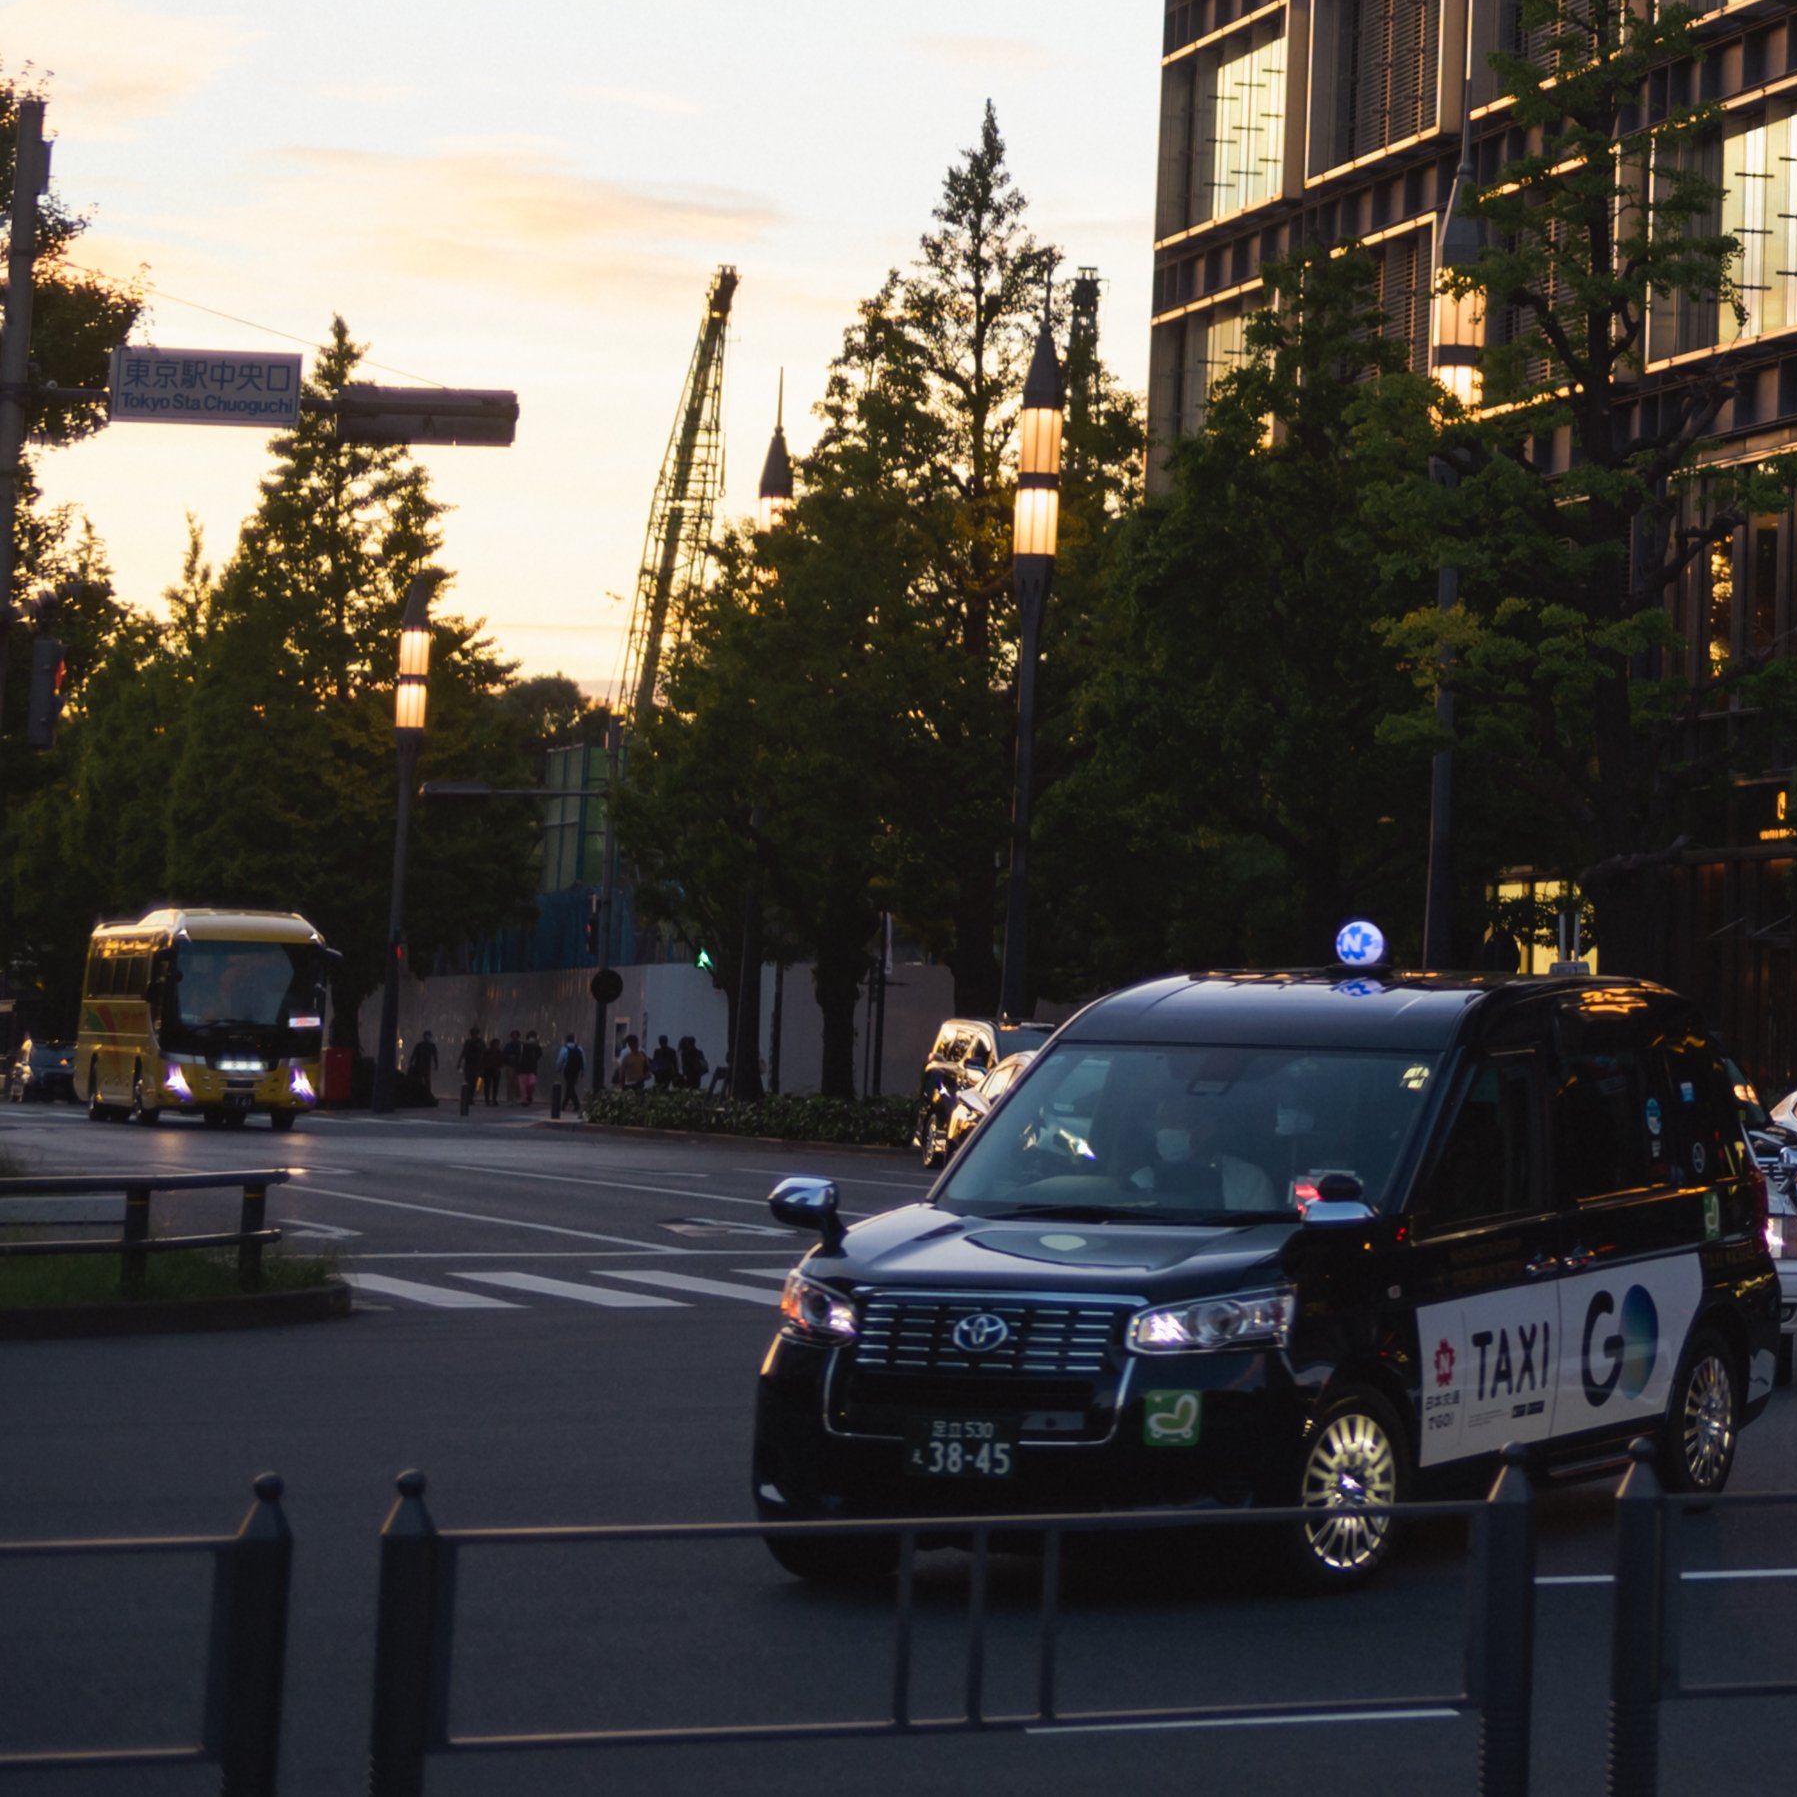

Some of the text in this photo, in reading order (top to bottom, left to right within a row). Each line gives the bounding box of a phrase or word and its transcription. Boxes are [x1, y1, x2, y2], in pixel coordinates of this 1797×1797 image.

[123, 358, 293, 392] 東京駅中央口
[121, 392, 170, 411] Tokyo
[204, 394, 293, 415] Chuoguchi
[1472, 1284, 1658, 1407] TAXI GO
[932, 1420, 994, 1439] 足立 530
[928, 1440, 1012, 1475] 38-45
